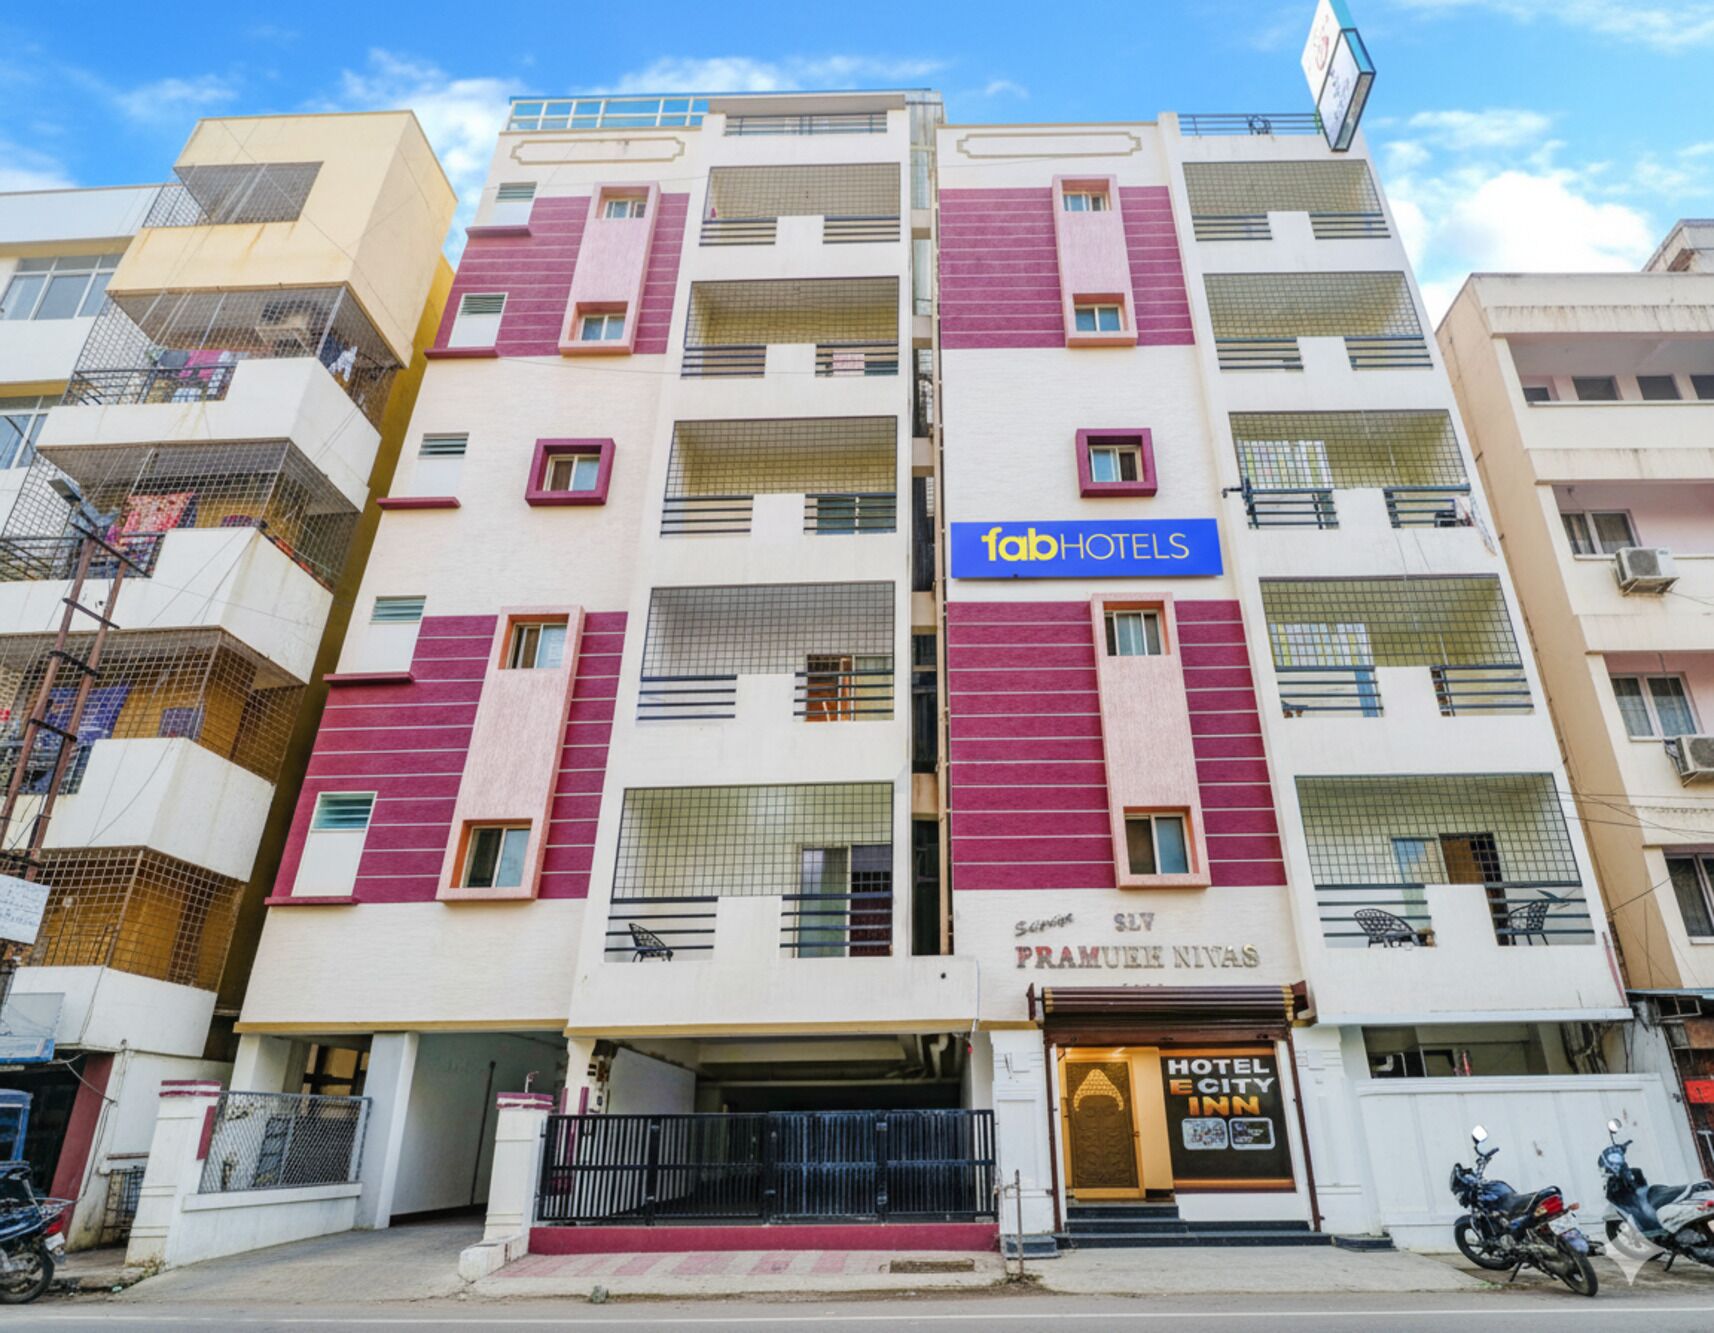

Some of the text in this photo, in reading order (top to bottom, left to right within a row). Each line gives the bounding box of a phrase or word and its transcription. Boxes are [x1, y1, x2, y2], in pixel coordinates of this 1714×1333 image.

[981, 527, 1190, 561] fabHOTELS
[1113, 912, 1155, 932] SLV
[1171, 943, 1260, 968] NIVAS
[1167, 1058, 1270, 1075] HOTEL
[1169, 1077, 1275, 1096] E CITY
[1188, 1095, 1261, 1117] INN
